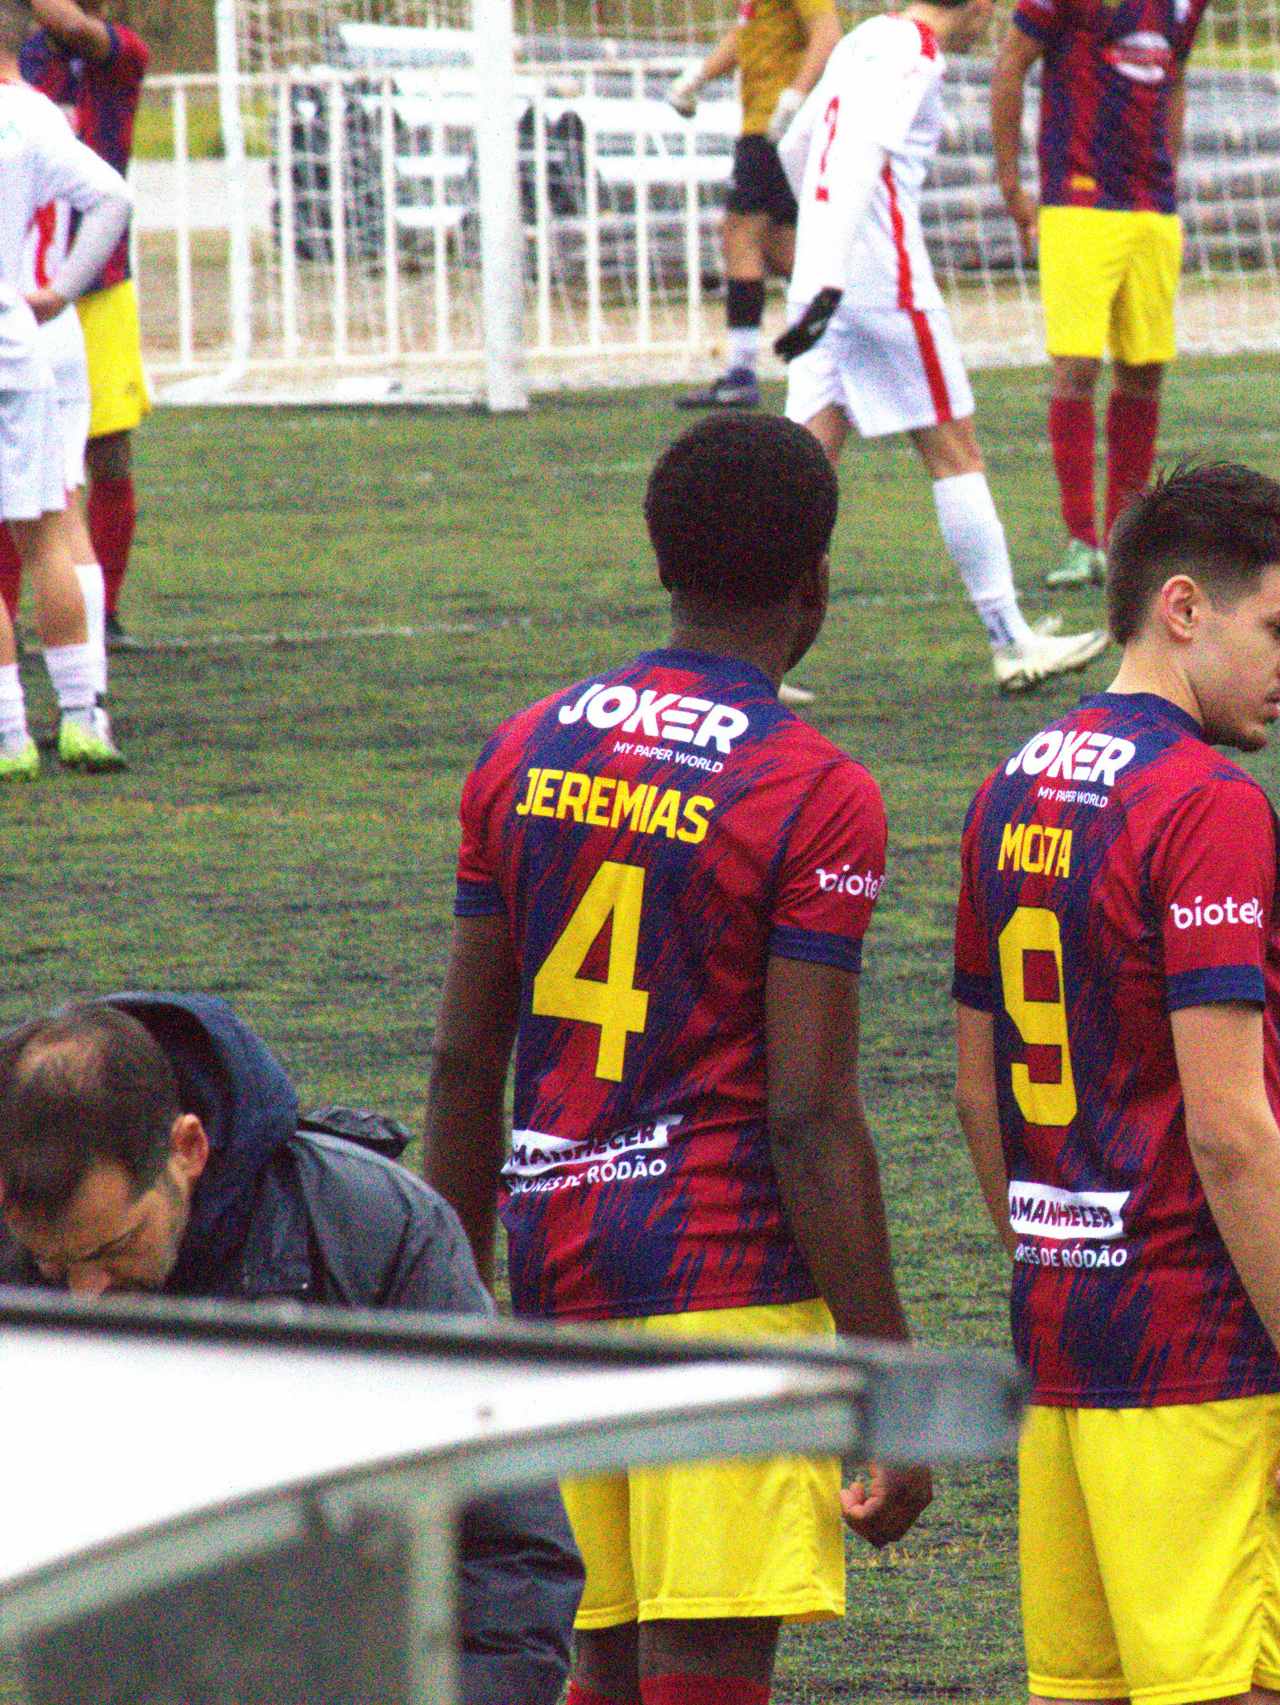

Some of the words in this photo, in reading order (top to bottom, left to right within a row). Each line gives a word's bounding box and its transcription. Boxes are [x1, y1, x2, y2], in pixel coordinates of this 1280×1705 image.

[559, 683, 749, 754] JOKER
[613, 740, 635, 756] MY
[634, 744, 673, 762] PAPER
[675, 751, 724, 773] WORLD
[1005, 730, 1136, 786] JOKER
[516, 767, 715, 845] JEREMIAS
[1037, 786, 1057, 801] MY
[1077, 791, 1108, 808] WORLD
[997, 822, 1073, 878] MOTA
[1169, 895, 1264, 930] biotek
[532, 860, 650, 1083] 4
[998, 906, 1078, 1127] 9
[586, 1155, 668, 1185] RÓDÃO
[1009, 1195, 1115, 1229] AMANHECER
[1041, 1247, 1061, 1267] DE
[1061, 1243, 1128, 1268] RÓDÃO
